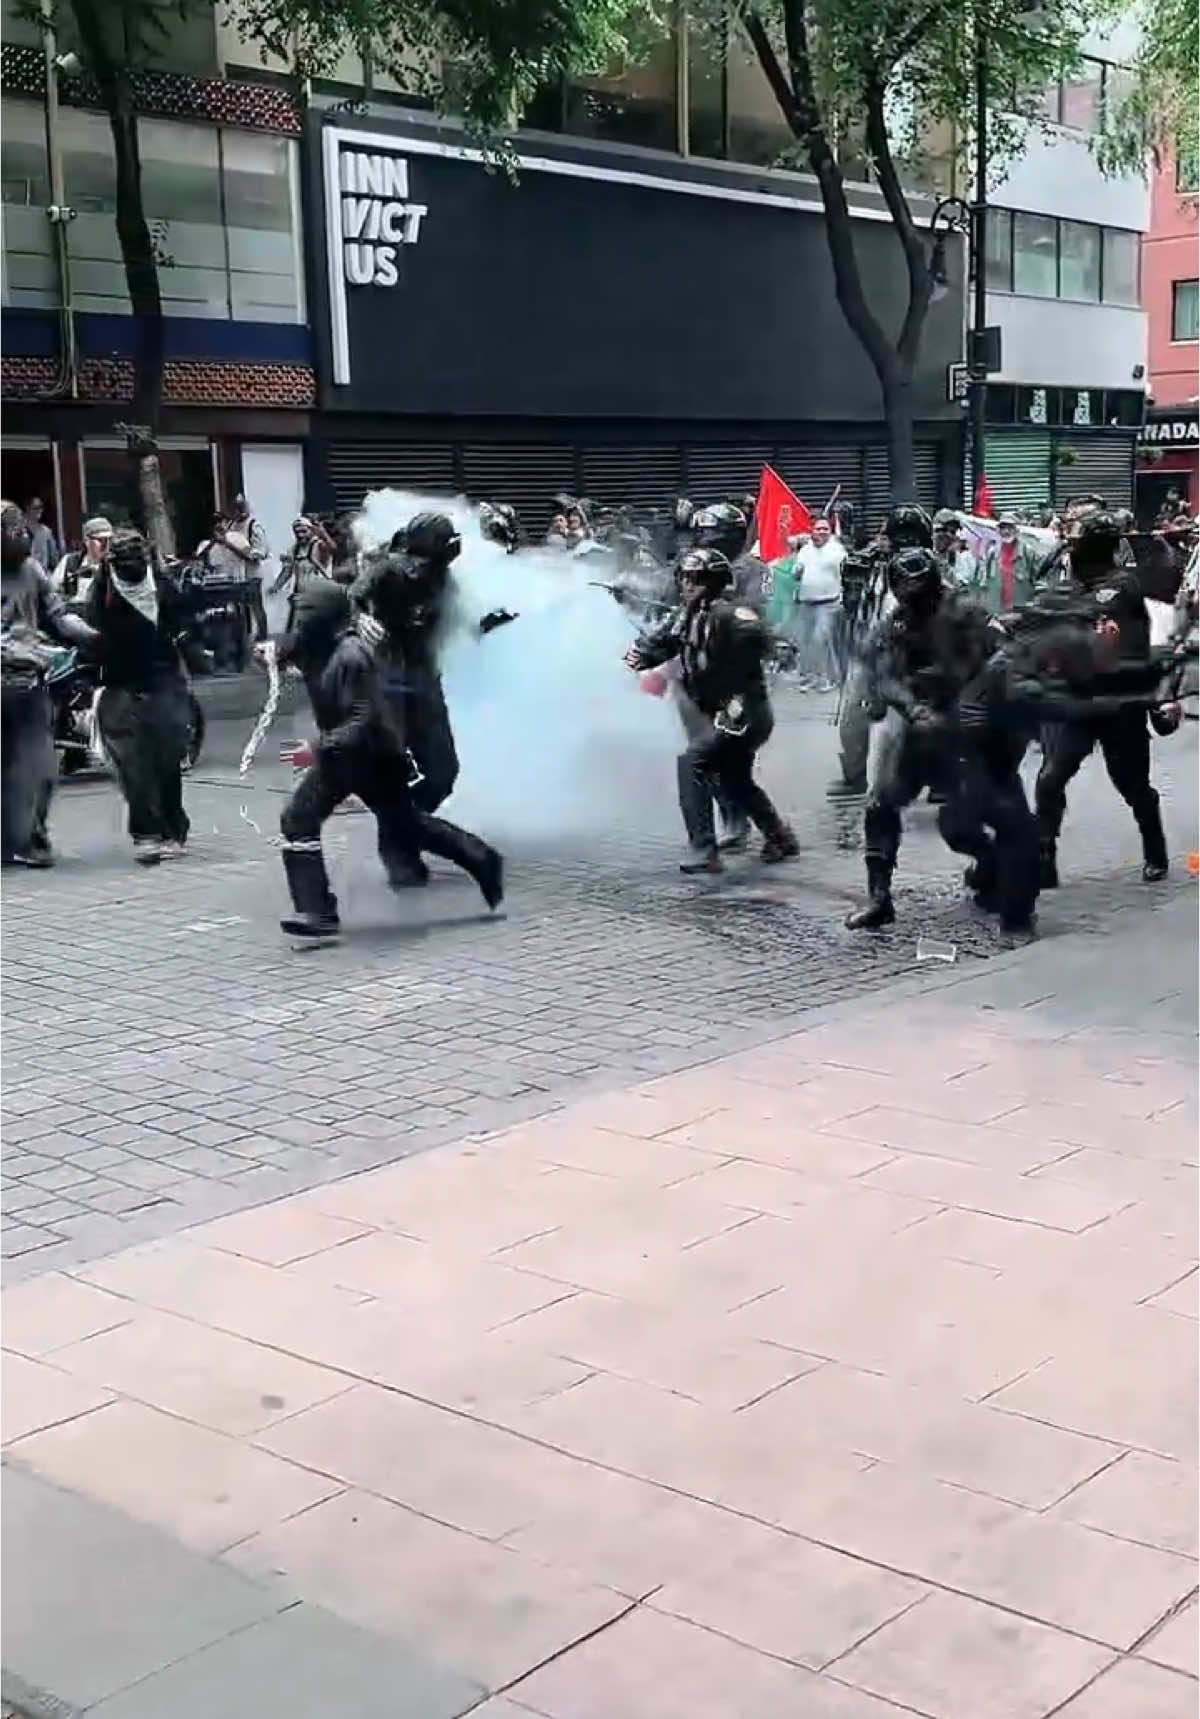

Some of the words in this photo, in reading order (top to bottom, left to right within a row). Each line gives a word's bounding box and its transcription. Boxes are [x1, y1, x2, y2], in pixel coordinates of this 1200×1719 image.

[341, 152, 408, 198] INN
[343, 197, 428, 243] VICT
[345, 243, 398, 286] US
